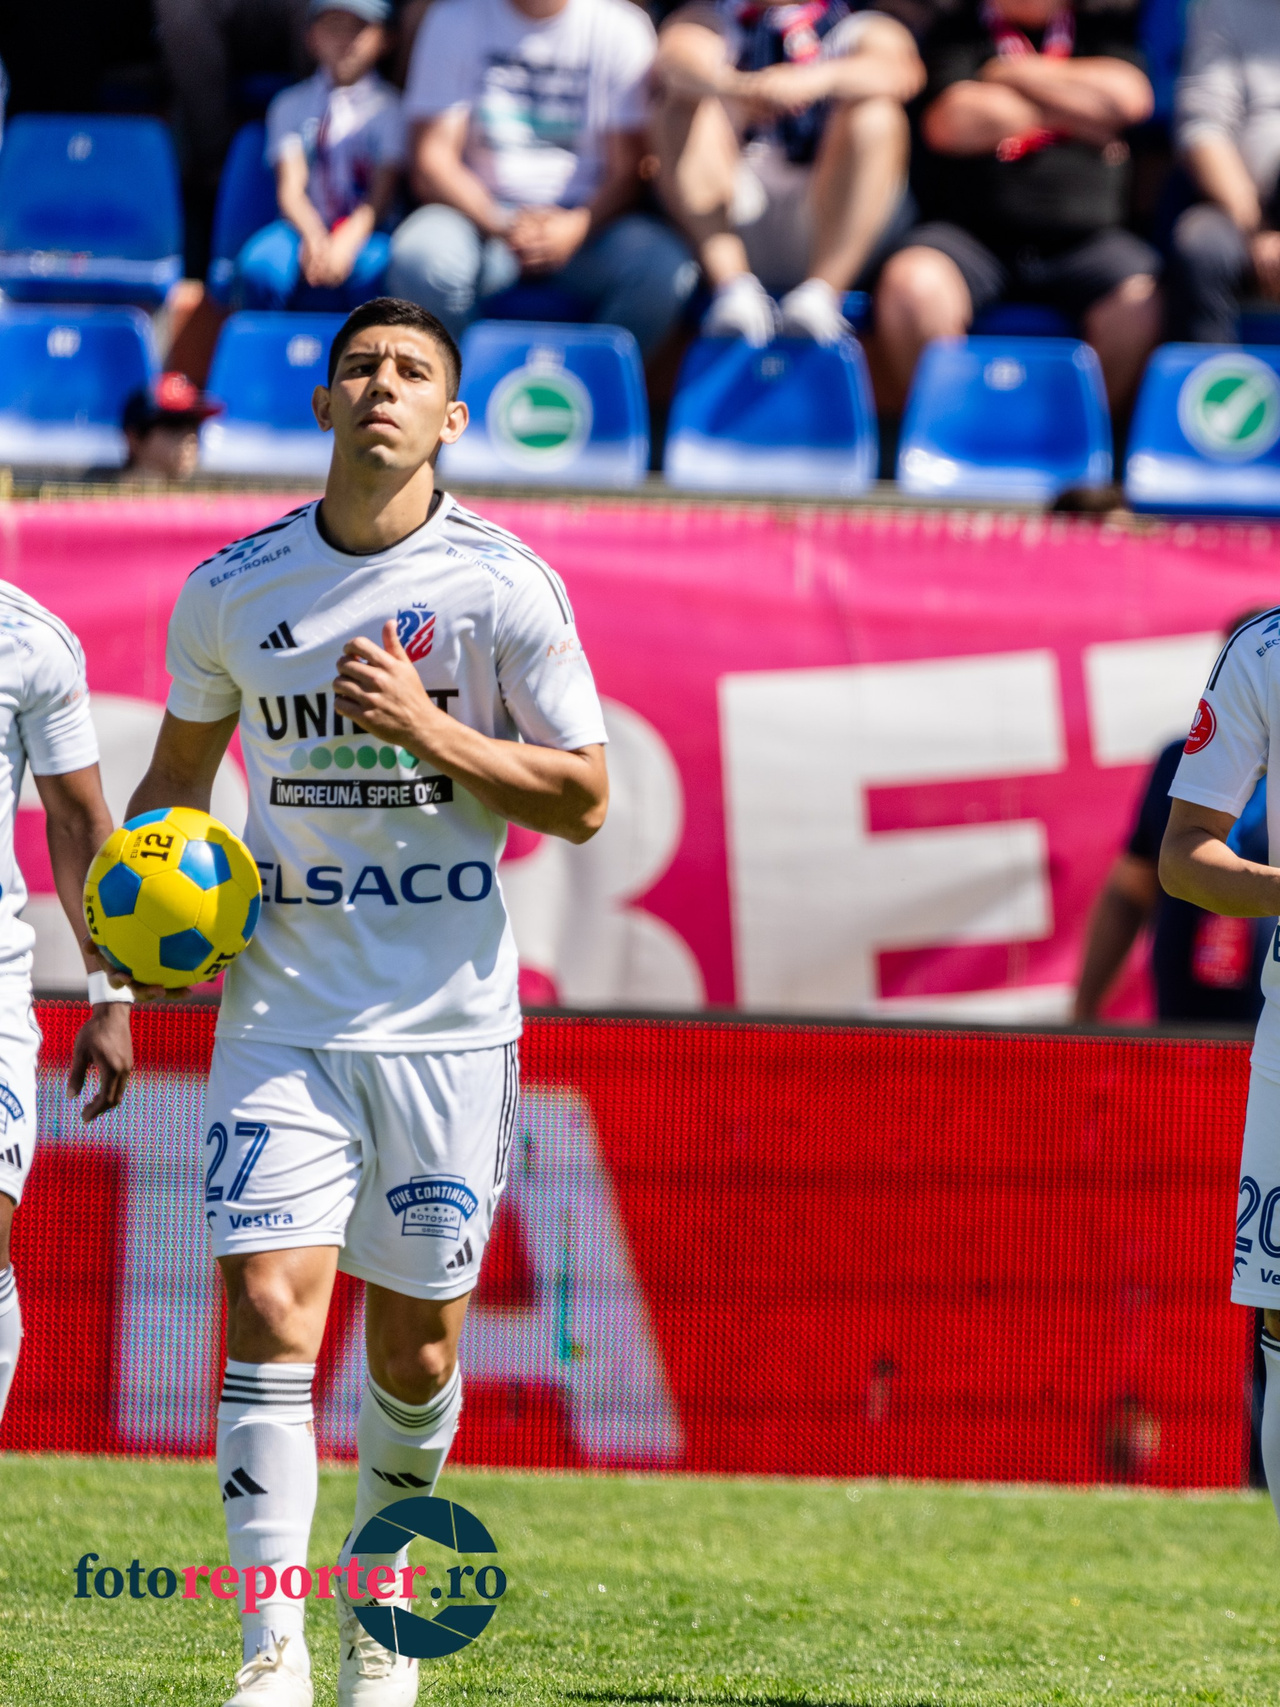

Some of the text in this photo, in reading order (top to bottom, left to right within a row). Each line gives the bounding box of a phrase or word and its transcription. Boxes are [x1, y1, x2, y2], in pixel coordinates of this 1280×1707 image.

[209, 545, 292, 588] ELECTROALFA
[258, 688, 459, 741] UNIT
[276, 779, 442, 806] ÎMPREUNĂ SPRE 0%
[140, 833, 174, 862] 12
[205, 1122, 270, 1202] 27
[390, 1186, 476, 1214] FIVE CONTINENTS
[229, 1212, 294, 1230] Vestra
